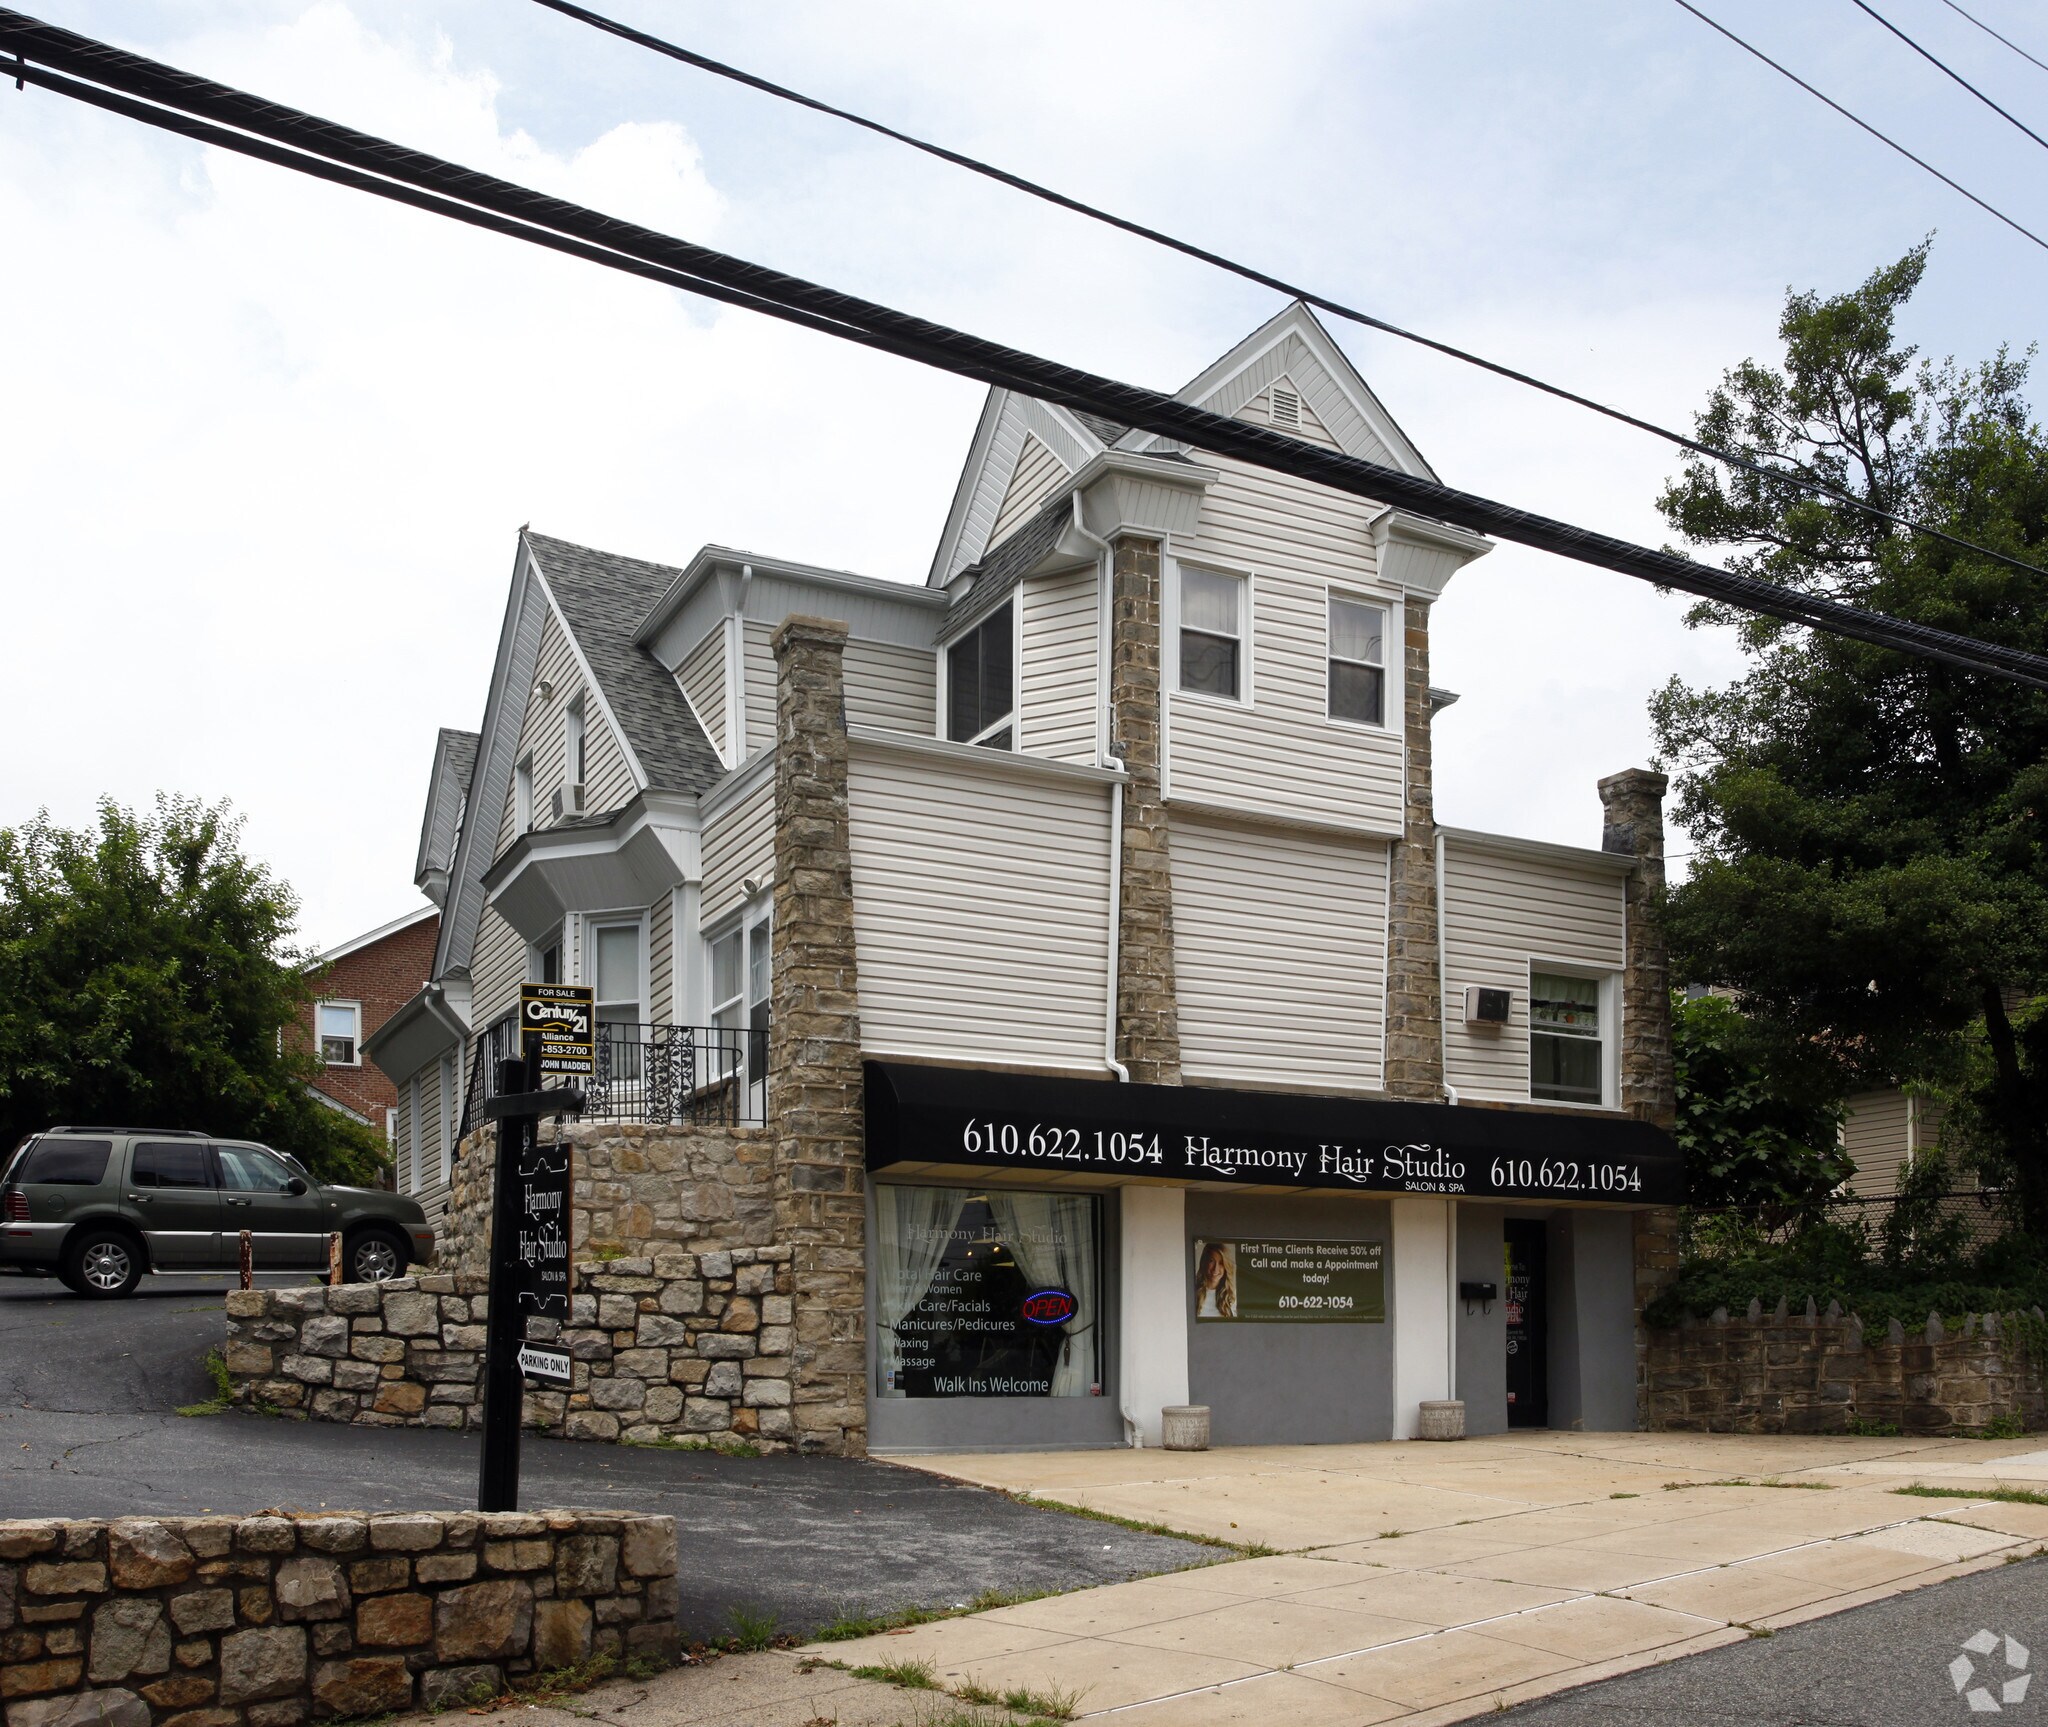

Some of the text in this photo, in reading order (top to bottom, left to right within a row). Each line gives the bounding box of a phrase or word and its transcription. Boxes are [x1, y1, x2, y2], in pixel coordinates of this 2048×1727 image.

[538, 988, 554, 996] FOR
[527, 1001, 578, 1022] Century
[573, 1016, 587, 1033] 21
[542, 1033, 574, 1041] Alliance
[542, 1045, 587, 1055] -853-2700
[541, 1060, 591, 1071] JOHN MADDEN
[963, 1118, 1641, 1192] 610.622.1054 Harmony Hair Studio 610.622.1054
[1405, 1181, 1465, 1192] SALON & SPA
[524, 1184, 562, 1221] Harmony
[908, 1224, 1068, 1246] Harmony Hair Studio
[519, 1221, 567, 1268] Hair Studio
[1241, 1243, 1381, 1255] First Time Clients Receive 50% off
[1251, 1258, 1268, 1268] Call
[1270, 1258, 1287, 1269] and
[1290, 1259, 1314, 1269] make
[1325, 1259, 1379, 1271] Appointment
[541, 1271, 554, 1281] SALON
[559, 1272, 567, 1281] SPA
[896, 1268, 920, 1280] otal
[953, 1269, 982, 1281] Care
[1302, 1273, 1330, 1286] today!
[926, 1284, 962, 1294] Women
[1510, 1287, 1528, 1302] Hair
[919, 1299, 991, 1313] Care/Facials
[1023, 1298, 1072, 1319] OPEN
[1278, 1296, 1353, 1309] 610-622-1054
[889, 1318, 1016, 1331] Manicures/Pedicures
[521, 1353, 568, 1373] PARKING ONLY
[934, 1376, 1049, 1393] Walk Ins Welcome
